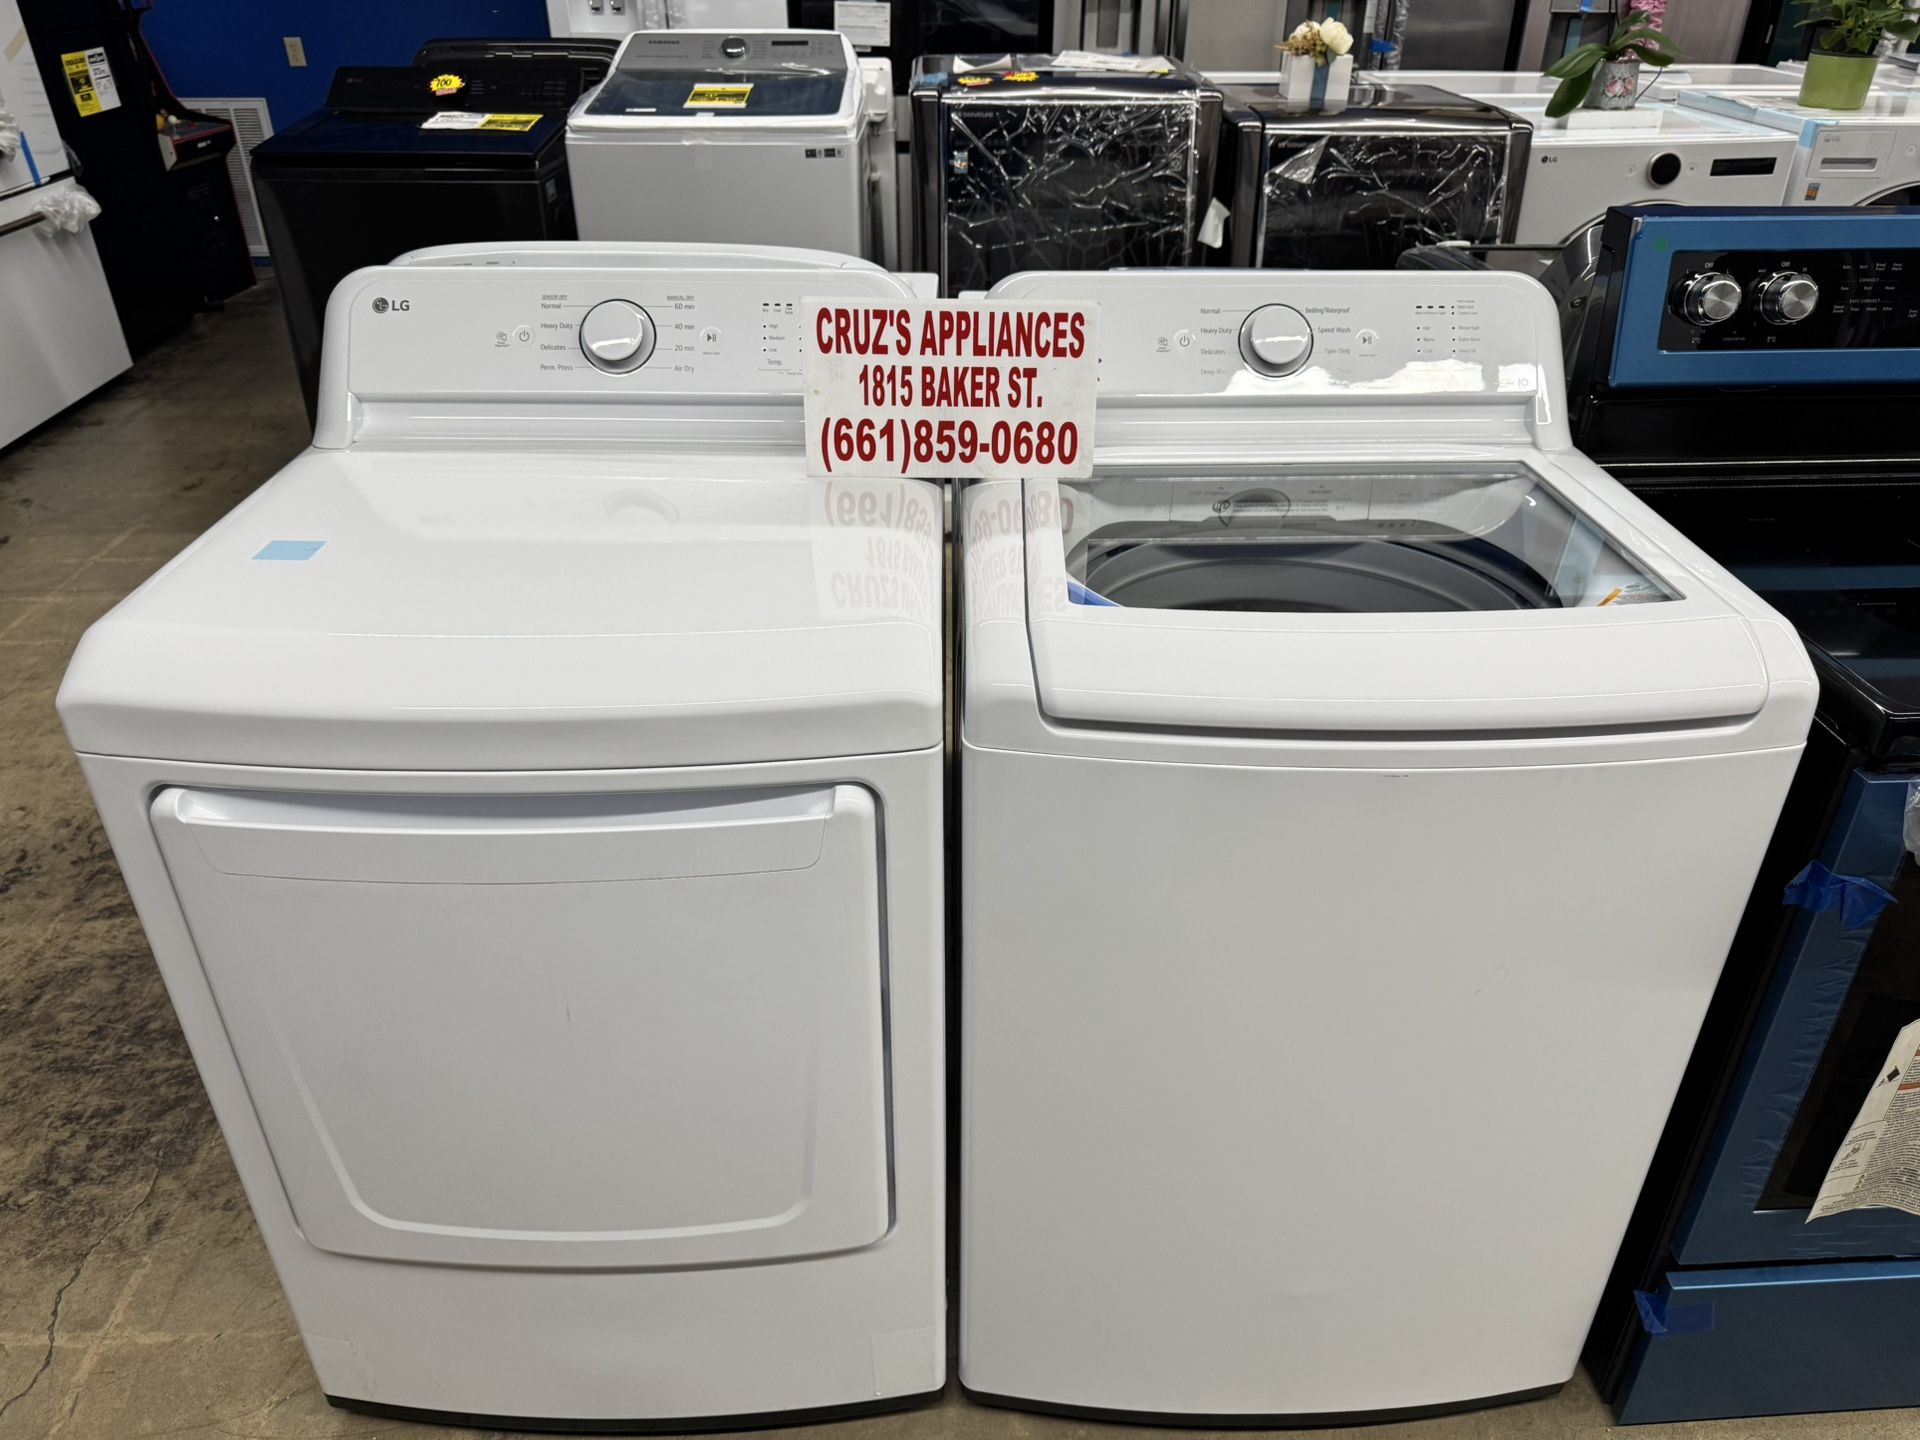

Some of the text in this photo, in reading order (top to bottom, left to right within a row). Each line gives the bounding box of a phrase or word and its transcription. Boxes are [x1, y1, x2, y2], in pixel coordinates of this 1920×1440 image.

[392, 299, 410, 311] LG
[816, 307, 1085, 359] CRUZ'S APPLIANCES
[1200, 327, 1232, 335] Heavy Duty
[1317, 326, 1335, 334] Speed
[684, 365, 695, 373] Dry
[859, 364, 1043, 408] 1815 BAKER ST.
[821, 417, 1078, 474] (661)859-0680
